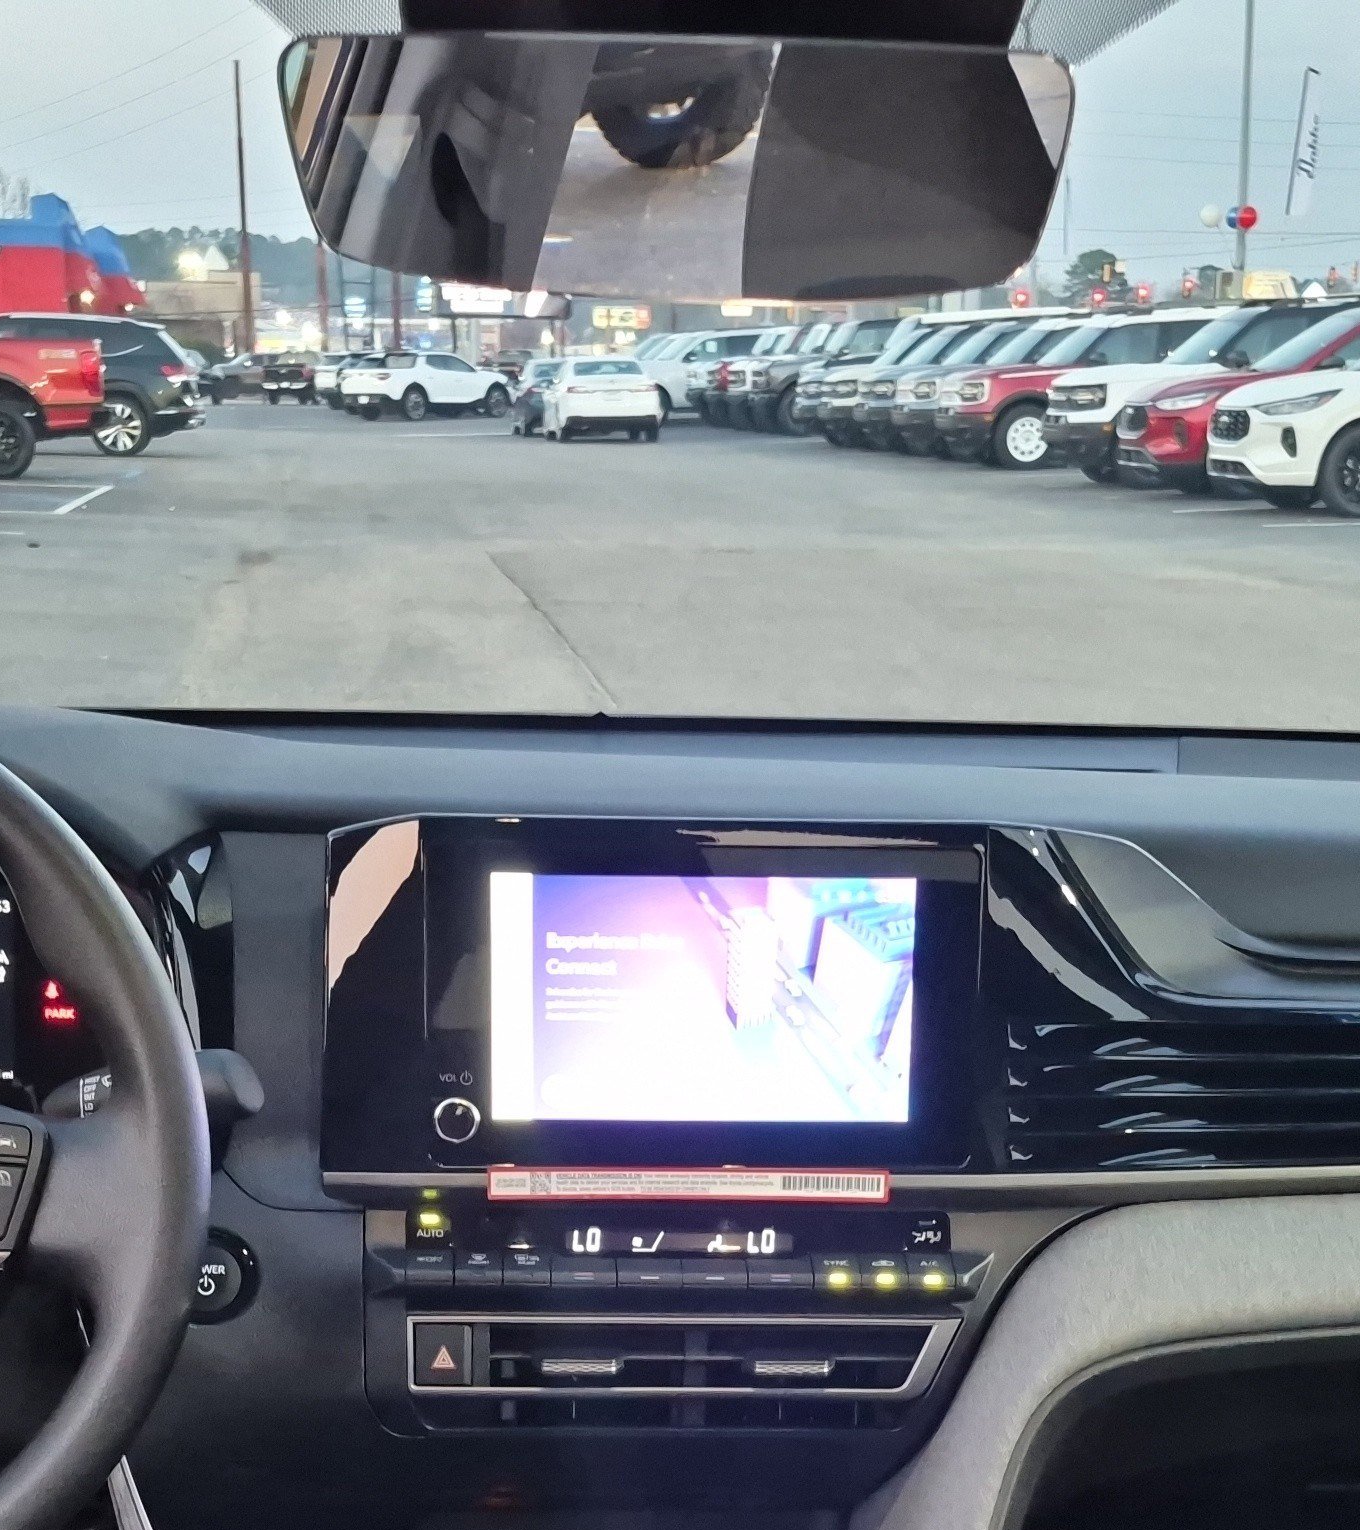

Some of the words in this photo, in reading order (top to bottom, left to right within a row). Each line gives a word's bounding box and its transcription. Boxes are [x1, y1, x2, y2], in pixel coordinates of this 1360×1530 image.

[44, 1007, 76, 1020] PARK
[416, 1229, 444, 1238] AUTO
[571, 1226, 602, 1253] LO
[747, 1228, 776, 1254] LO
